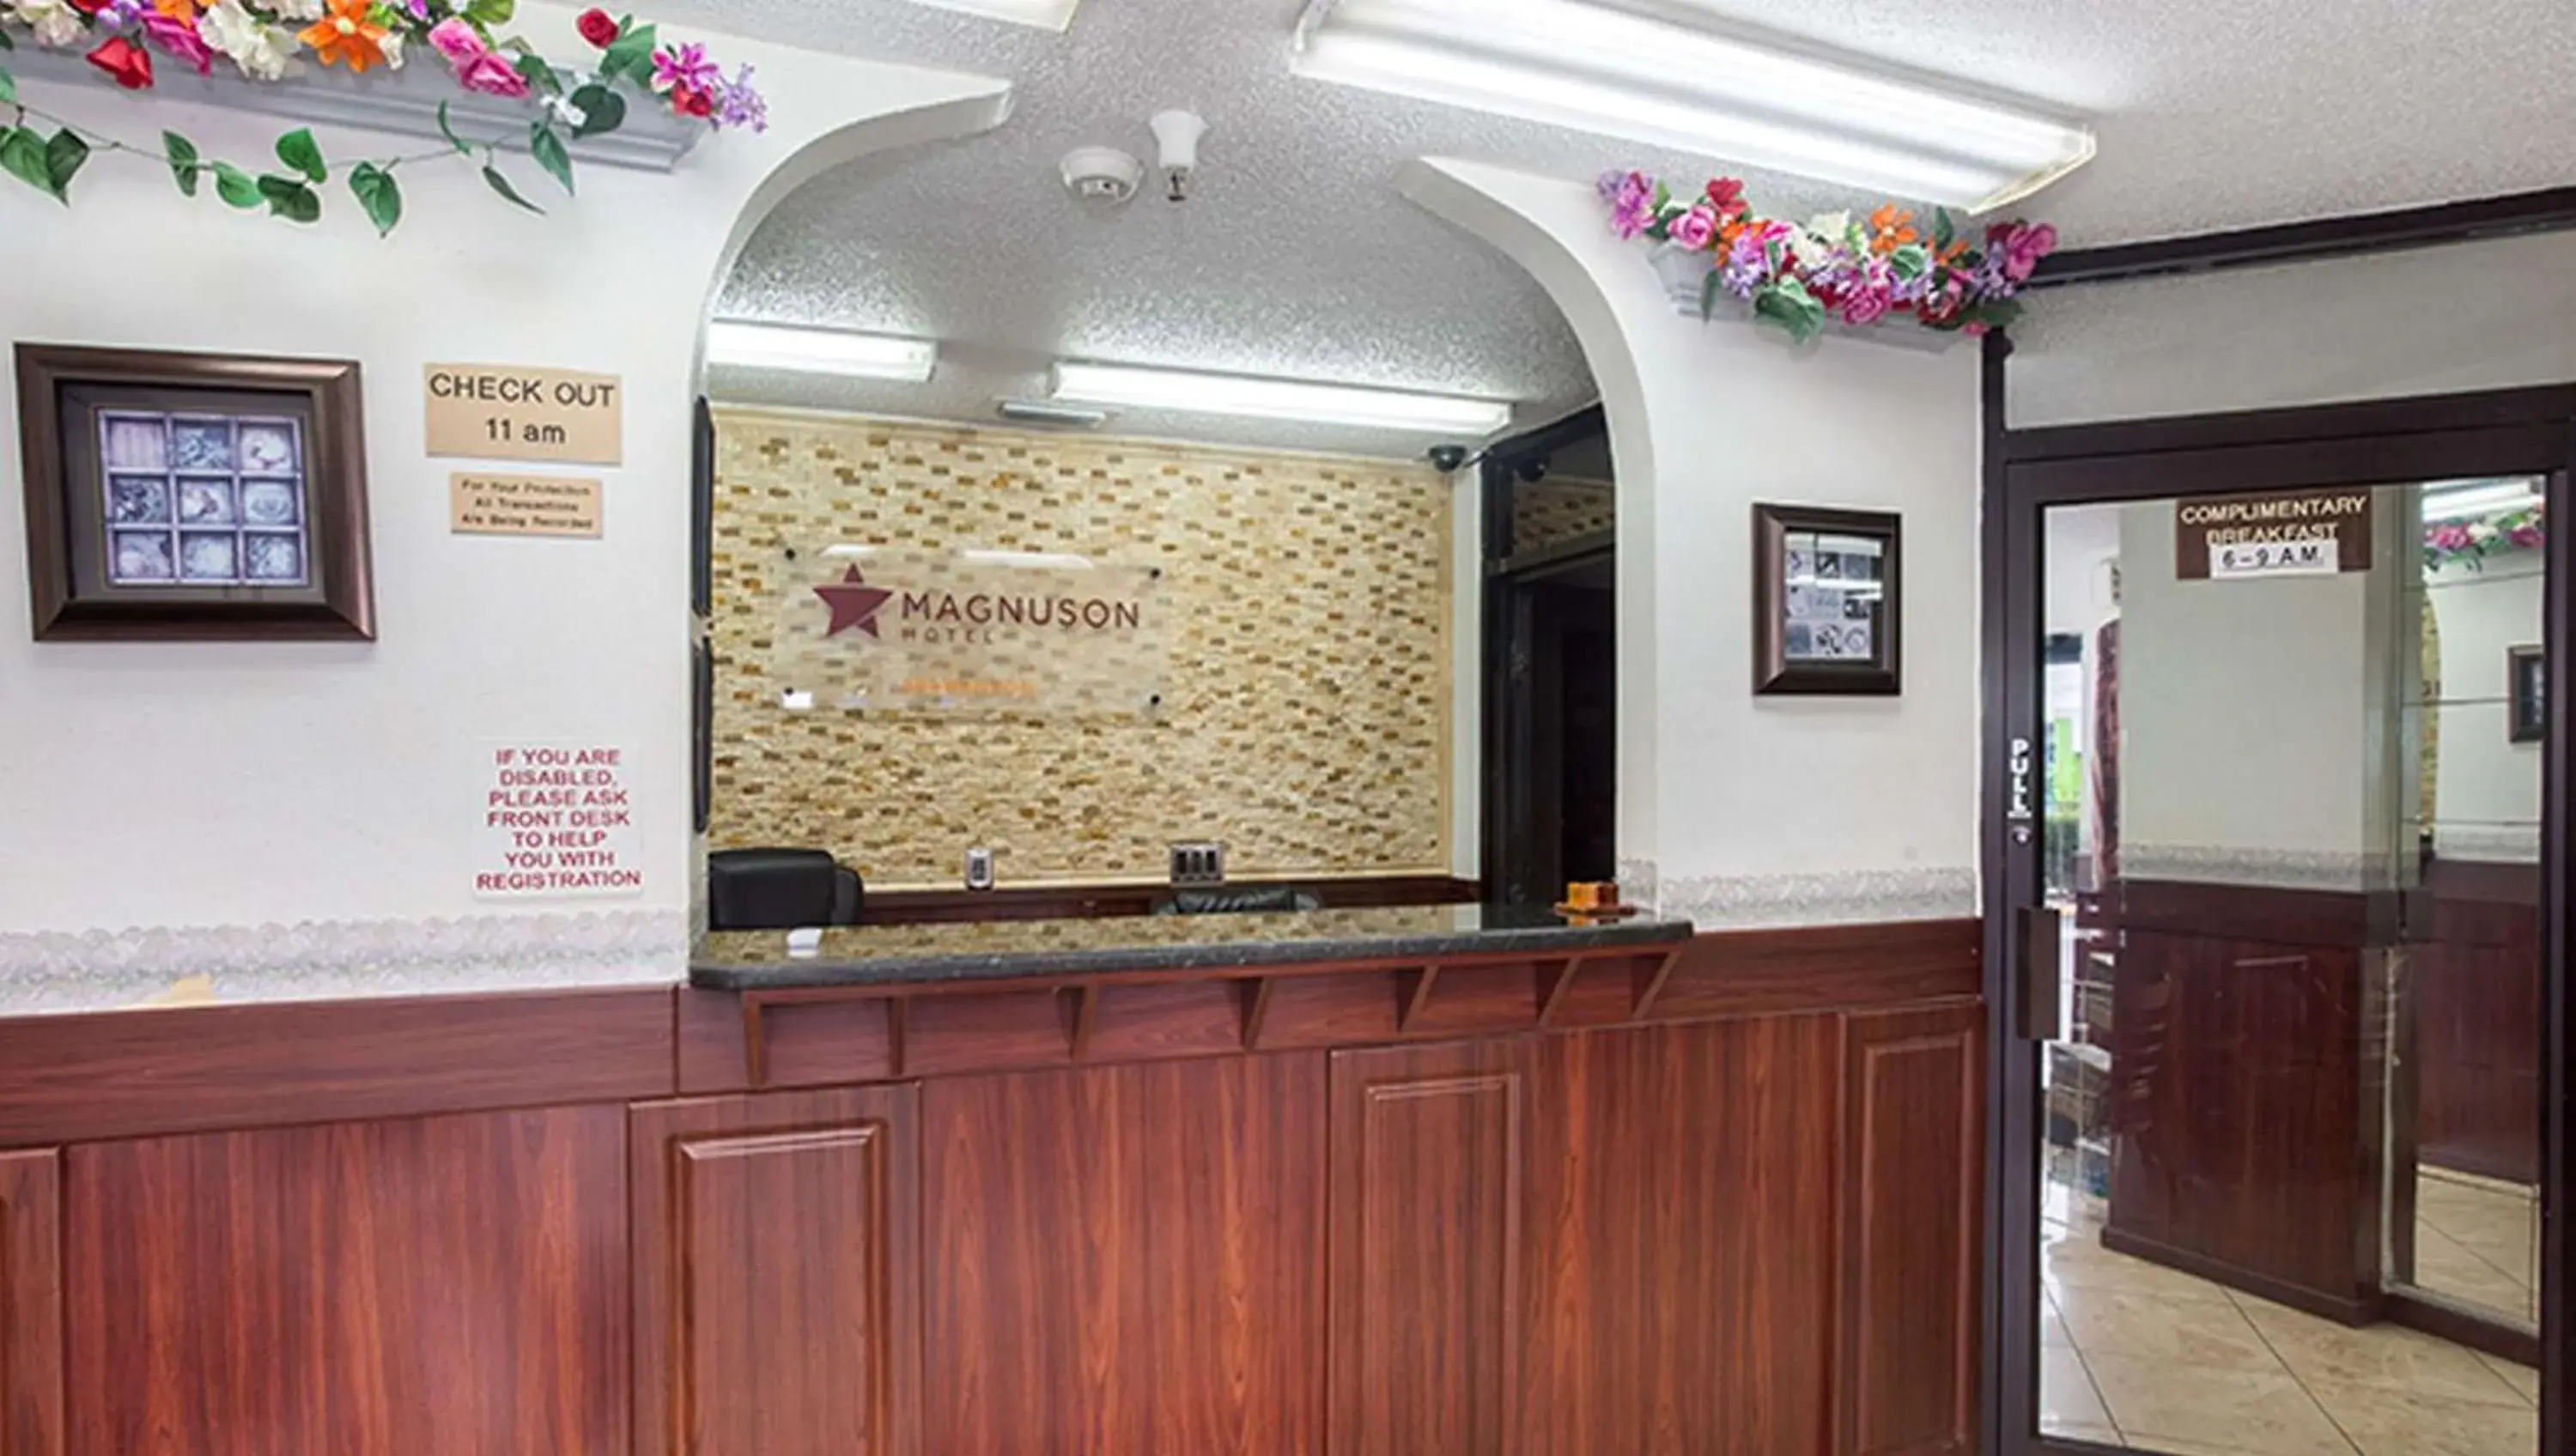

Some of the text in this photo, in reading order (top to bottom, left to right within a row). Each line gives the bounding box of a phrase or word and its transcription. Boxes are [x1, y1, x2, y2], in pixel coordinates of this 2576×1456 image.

[430, 373, 615, 407] CHECK OUT
[486, 417, 566, 444] 11 am
[2181, 496, 2366, 525] COMPLIMENTARY
[2206, 522, 2340, 545] BREAKFAST
[902, 592, 1139, 629] MAGNUSON
[902, 628, 993, 644] HOTEL
[495, 749, 620, 766] IF YOU ARE
[2010, 739, 2030, 811] PULL
[489, 790, 628, 807] PLEASE ASK
[487, 809, 629, 828] FRONT DESK
[513, 830, 608, 848] TO HELP
[505, 851, 614, 869] YOU WITH
[476, 870, 641, 890] REGISTRATION
